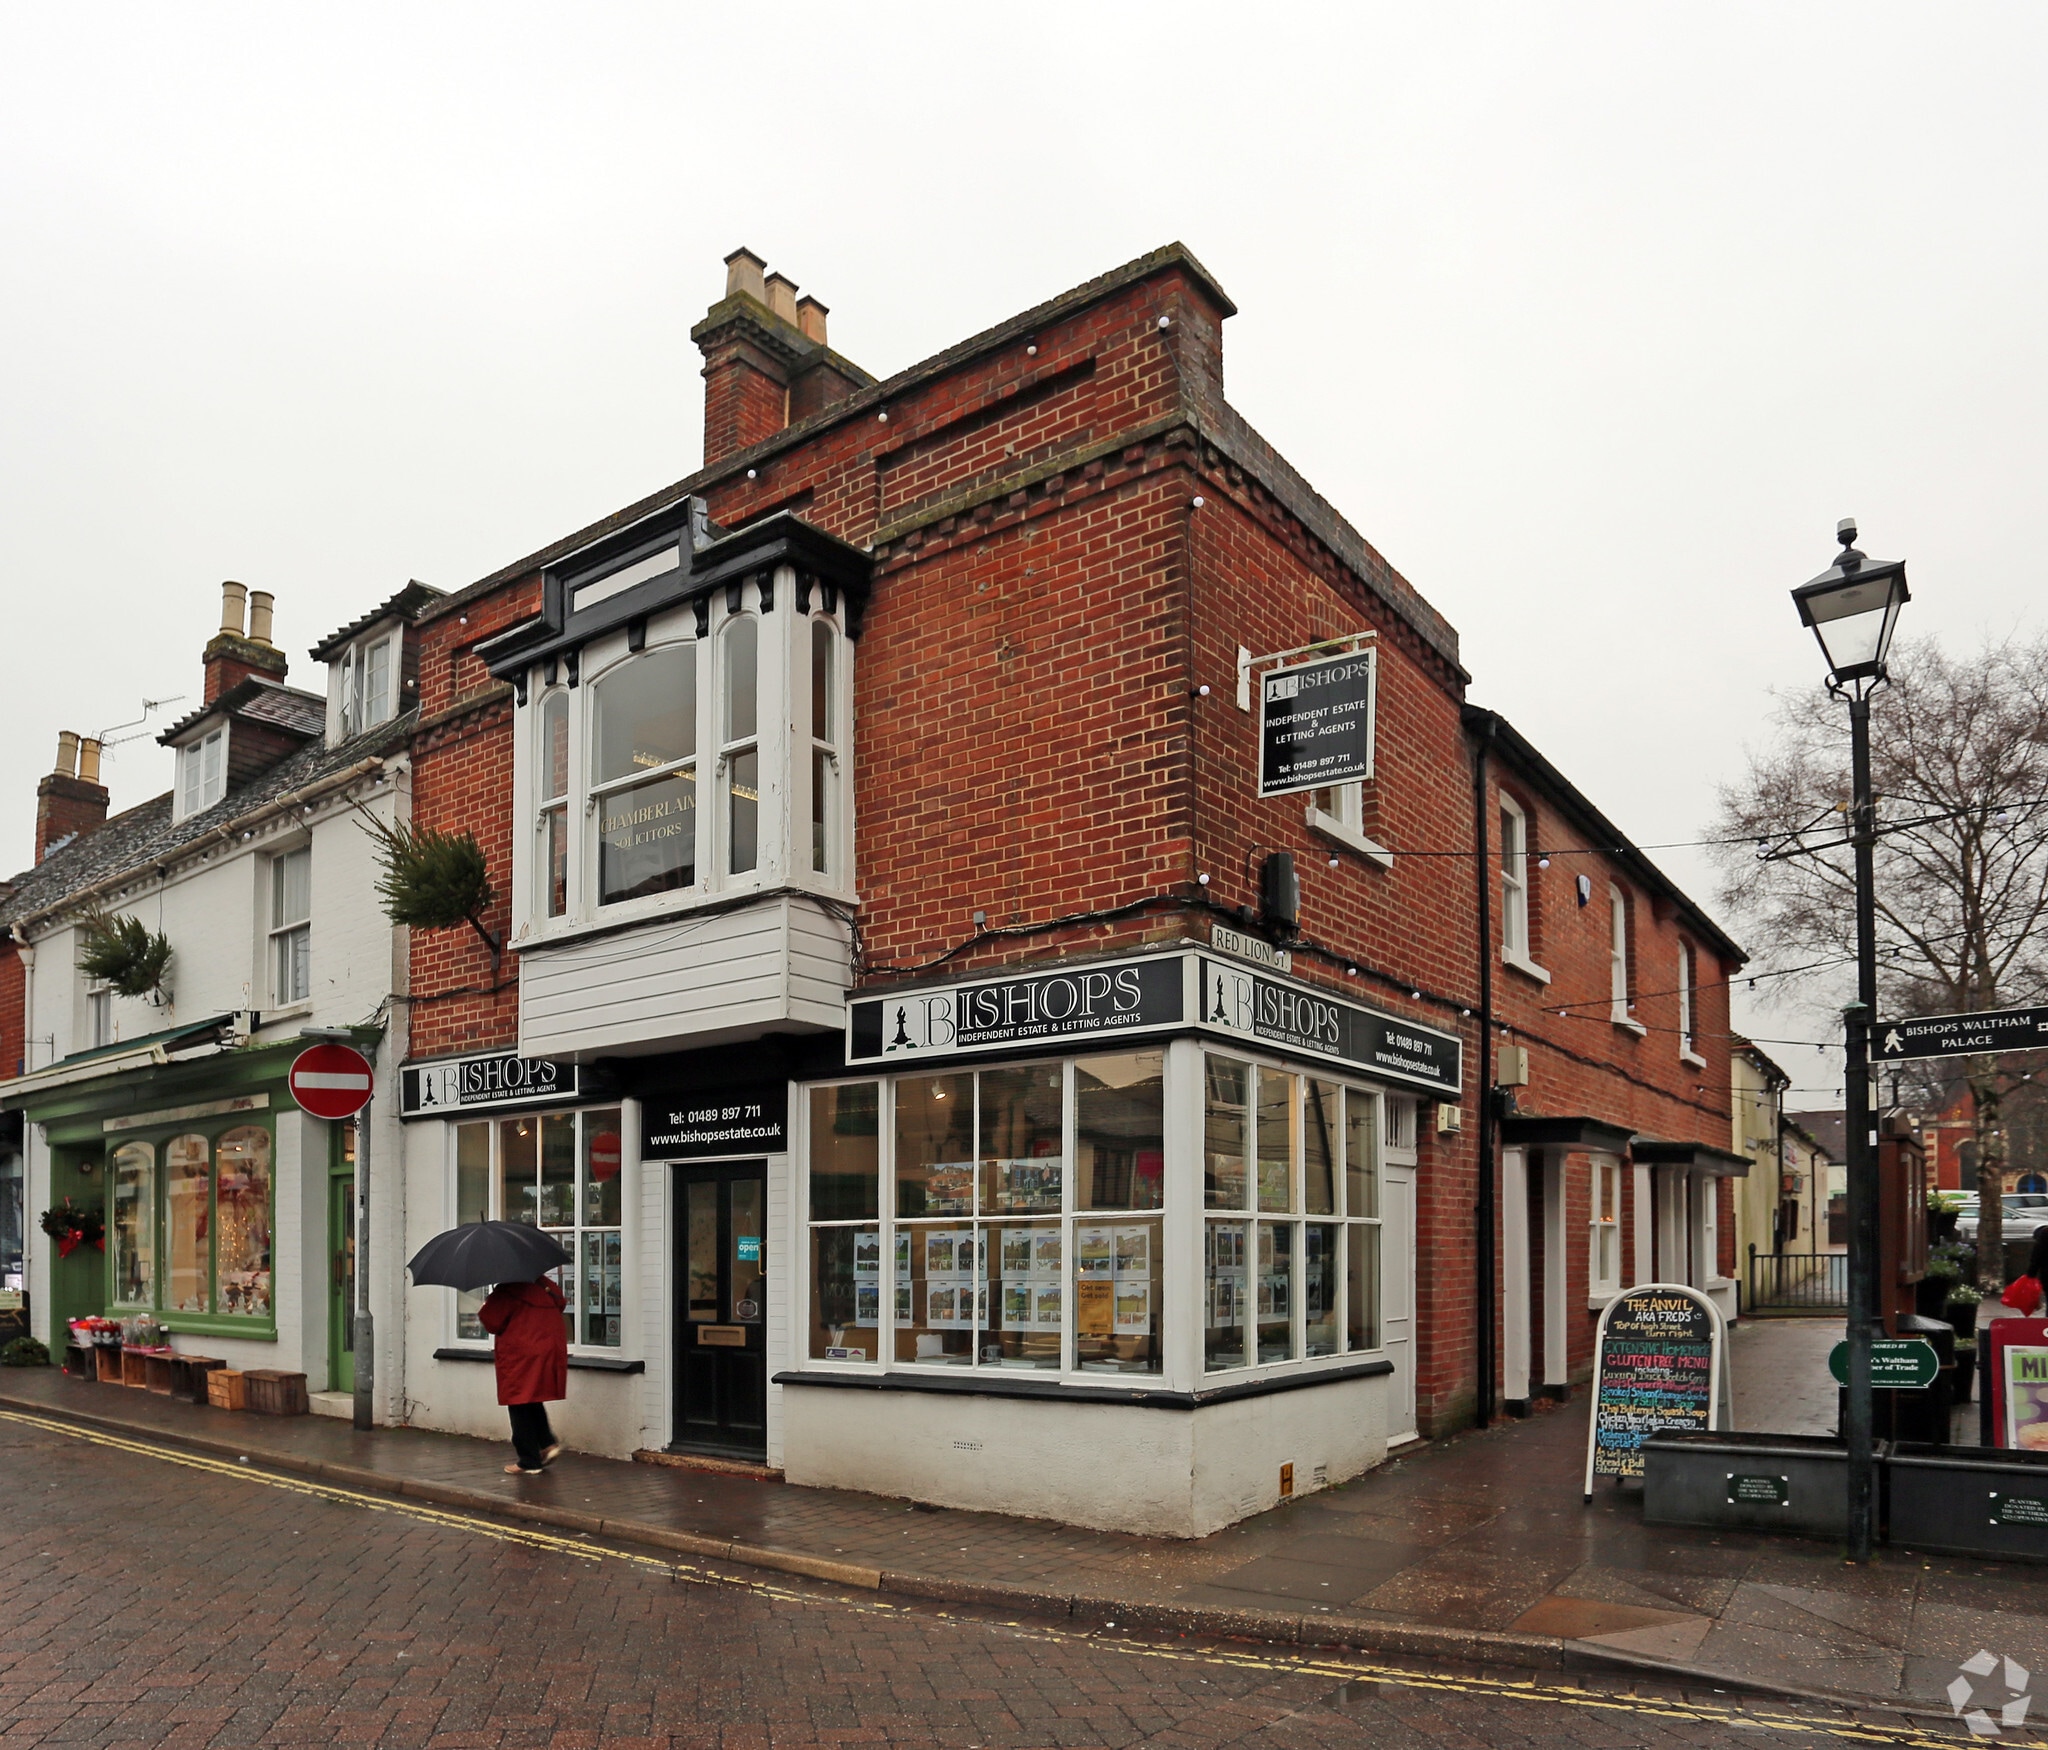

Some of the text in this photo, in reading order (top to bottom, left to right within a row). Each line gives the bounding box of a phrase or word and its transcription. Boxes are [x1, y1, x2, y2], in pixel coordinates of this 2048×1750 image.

[1283, 660, 1369, 697] BISHOPS
[1266, 699, 1366, 728] INDEPENDENT ESTATE
[1311, 719, 1319, 728] &
[1275, 720, 1356, 745] LETTING AGENTS
[1278, 753, 1350, 774] Tel: 01489 897 711
[1263, 762, 1365, 788] www.bishopsestate.co.uk
[600, 795, 696, 834] CHAMBERLAIN
[614, 822, 682, 851] SOLICITORS
[1216, 929, 1240, 952] RED
[1244, 938, 1270, 963] LION
[920, 967, 1142, 1049] BISHOPS
[1231, 974, 1340, 1043] BISHOPS
[958, 1012, 1141, 1043] INDEPENDENT ESTATE & LETTING AGENTS
[1906, 1015, 2031, 1036] BISHOPS WALTHAM
[1255, 1025, 1340, 1056] INDEPENDENT ESTATE & LETTING AGENTS
[1385, 1031, 1433, 1056] Tel: 01489 897 711
[1942, 1035, 1993, 1048] PALACE
[1375, 1051, 1441, 1077] www.bishopsestate.co.uk
[439, 1057, 557, 1105] BISHOPS
[461, 1083, 556, 1103] INDEPENDENT ESTATE & LETTING AGENTS
[669, 1104, 761, 1125] Tel: 01489 897 711
[650, 1122, 781, 1145] www.bishopsestate.co.uk
[738, 1244, 759, 1254] open
[1624, 1297, 1694, 1312] THE ANVIL
[1635, 1311, 1692, 1322] AKA FREDS
[1668, 1330, 1694, 1338] right
[1603, 1341, 1660, 1354] EXTENSIVE
[1607, 1354, 1708, 1369] GLUTEN FREE MENU
[1602, 1369, 1637, 1382] Luxury
[1600, 1386, 1630, 1397] Smoked
[1656, 1406, 1685, 1418] Squash
[1686, 1408, 1707, 1420] Soup
[1600, 1420, 1625, 1430] White
[1595, 1466, 1619, 1474] other
[1596, 1456, 1620, 1467] Bread
